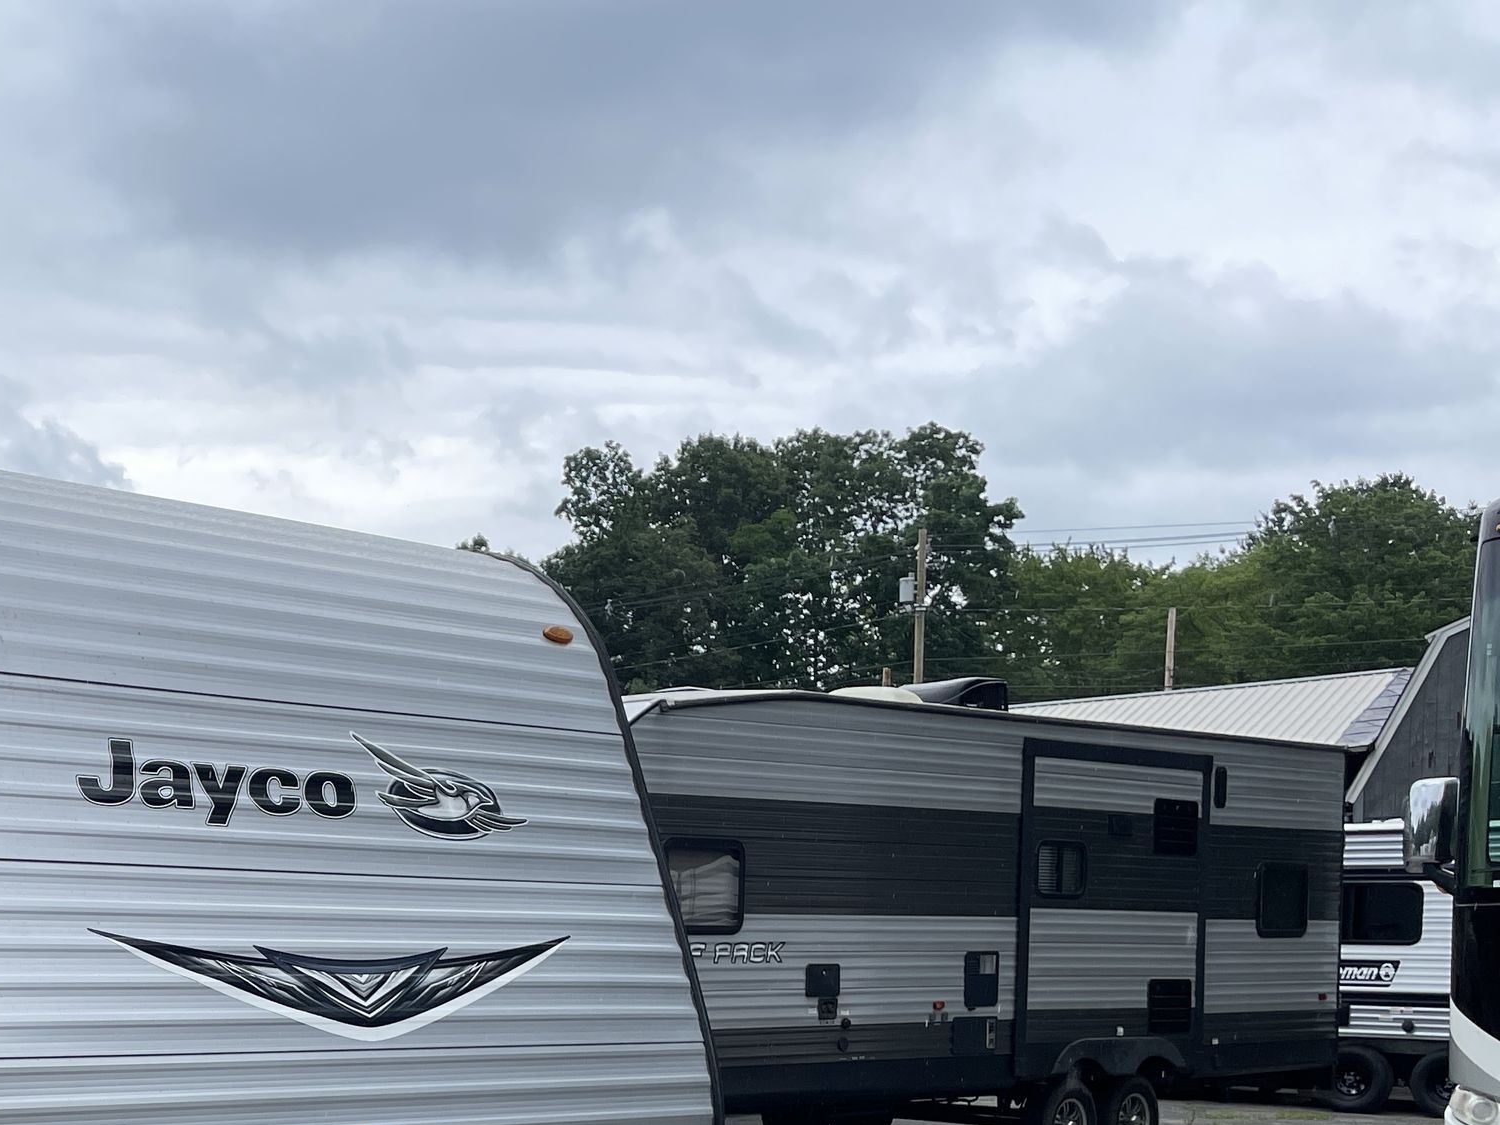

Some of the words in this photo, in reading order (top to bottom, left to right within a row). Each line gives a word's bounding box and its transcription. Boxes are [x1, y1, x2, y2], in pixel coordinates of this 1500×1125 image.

[76, 737, 358, 827] Jayco
[713, 941, 786, 964] PACK
[1340, 966, 1379, 980] man
